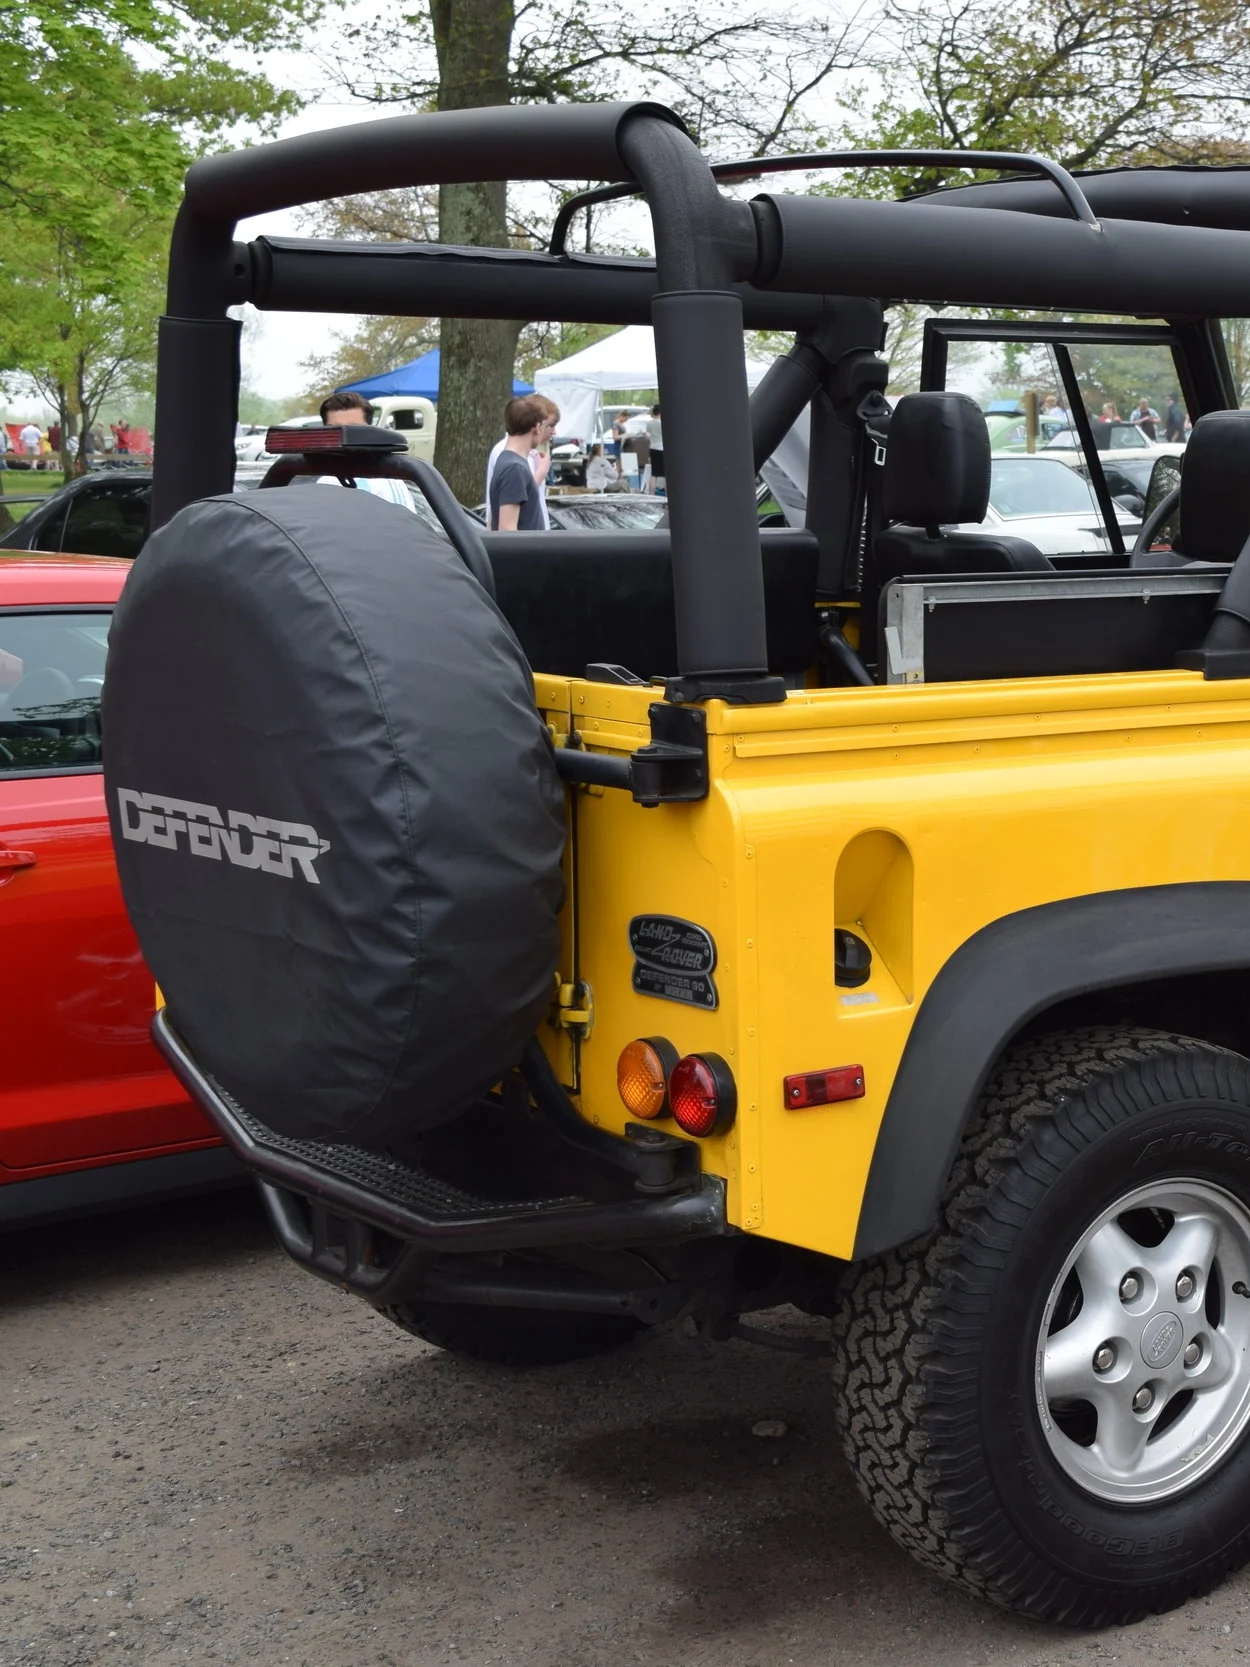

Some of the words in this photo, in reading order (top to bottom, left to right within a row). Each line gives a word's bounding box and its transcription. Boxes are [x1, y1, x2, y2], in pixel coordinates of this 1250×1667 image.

[117, 787, 330, 884] DEFENDER
[639, 920, 674, 942] LAND
[660, 946, 704, 970] ROVER
[639, 969, 690, 988] DEFENDER
[692, 980, 705, 992] 90
